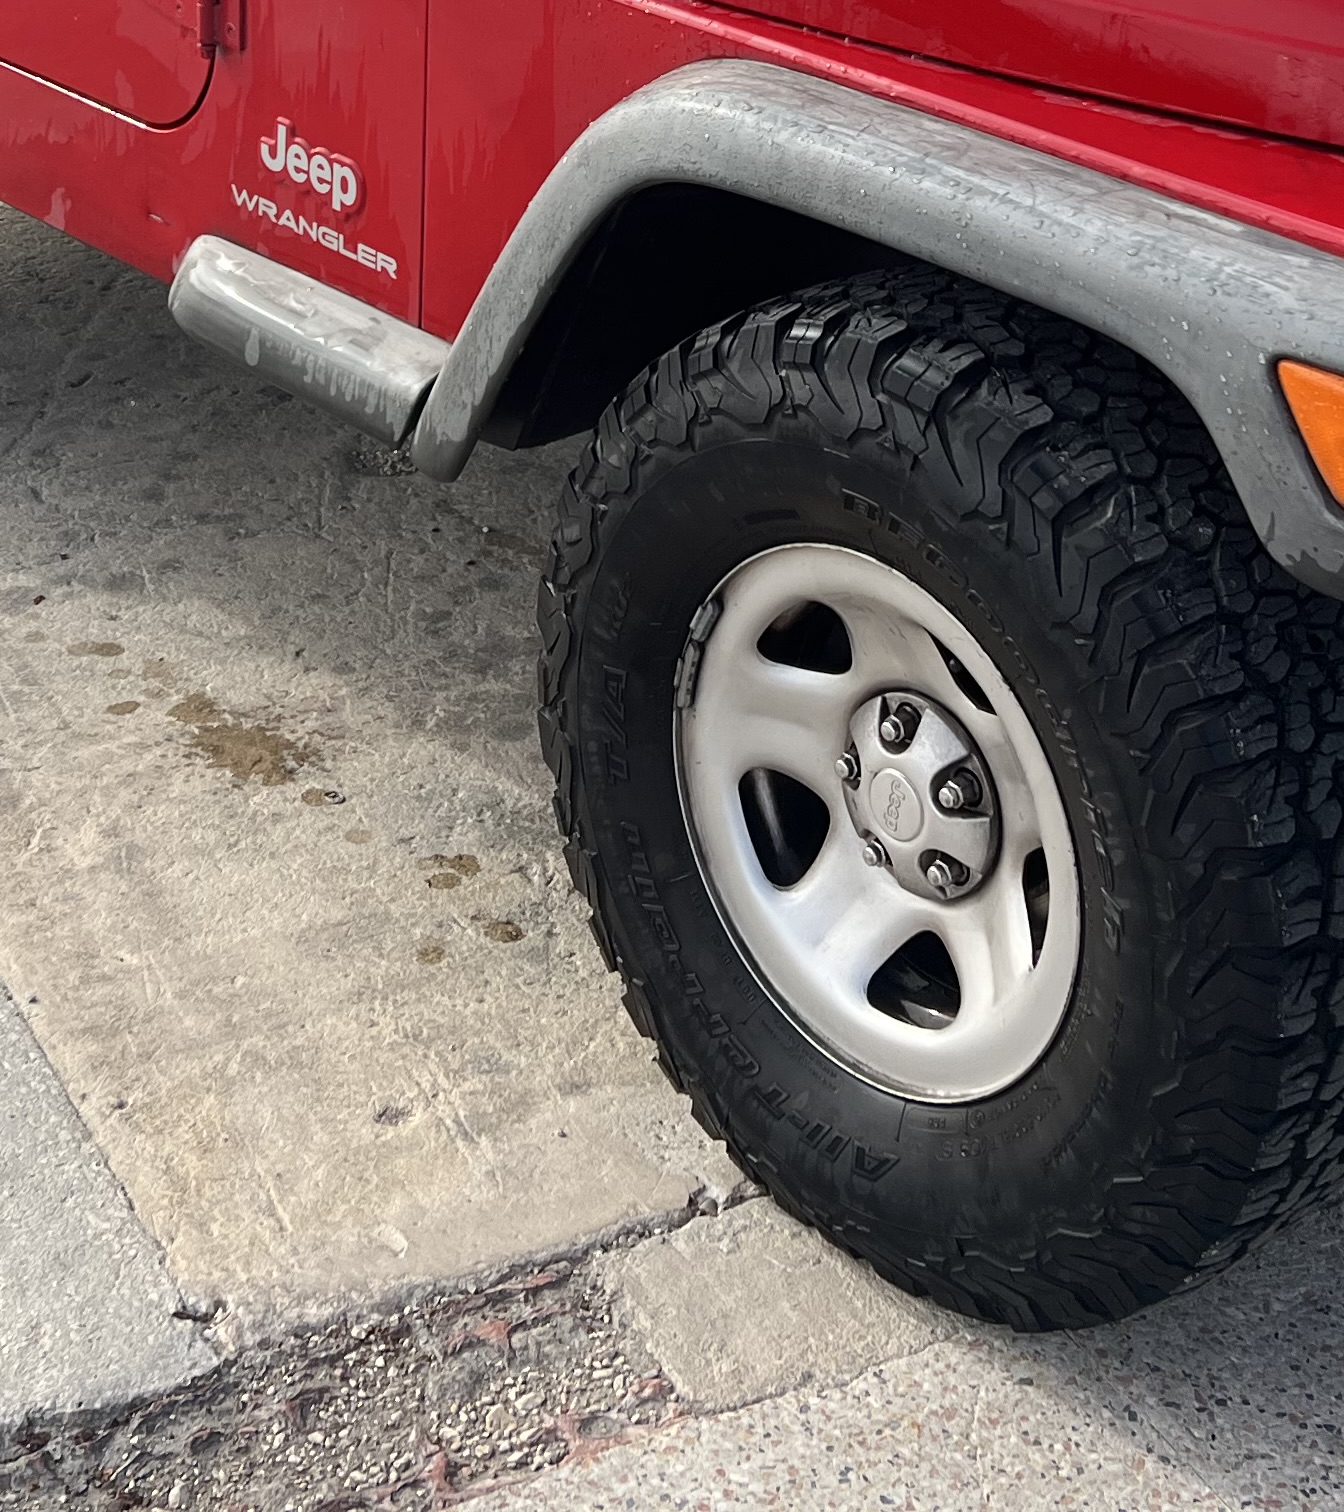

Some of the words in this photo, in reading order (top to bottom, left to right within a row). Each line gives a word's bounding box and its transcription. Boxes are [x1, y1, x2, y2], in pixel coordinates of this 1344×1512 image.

[260, 118, 361, 212] Jeep
[230, 183, 398, 280] WRANGLER
[883, 779, 906, 832] Jeep
